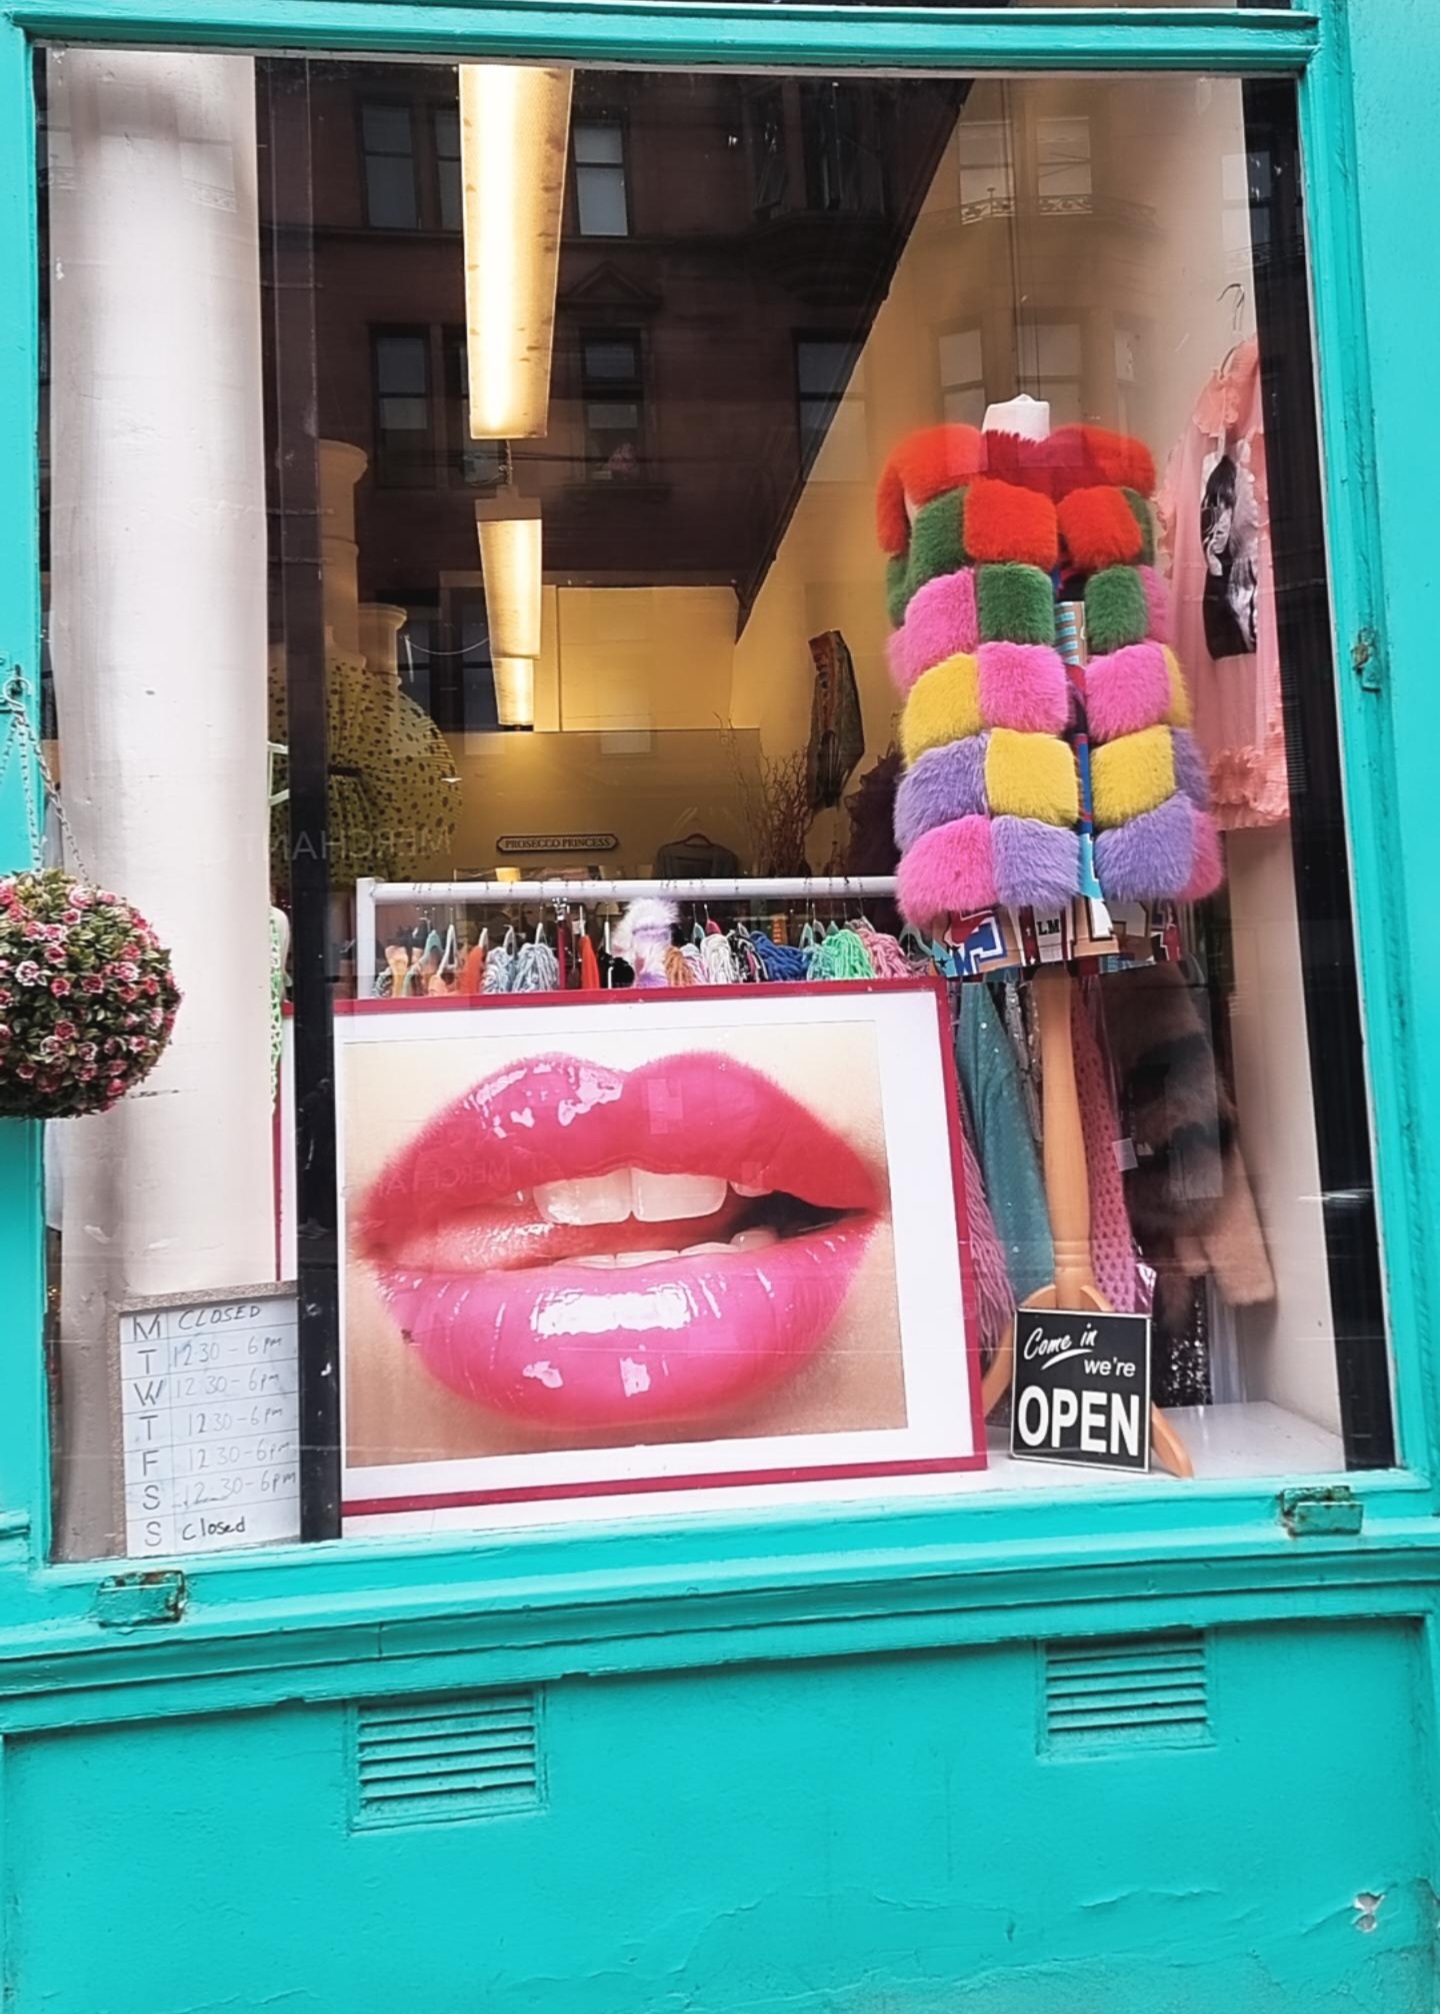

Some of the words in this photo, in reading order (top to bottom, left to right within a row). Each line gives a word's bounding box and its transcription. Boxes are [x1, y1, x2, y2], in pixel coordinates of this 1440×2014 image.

[505, 839, 560, 849] PROSECCO
[562, 837, 611, 848] PRINCESS
[133, 1313, 160, 1341] M
[178, 1305, 261, 1331] CLOSED
[1023, 1327, 1072, 1360] Come
[1080, 1322, 1098, 1347] in
[137, 1348, 157, 1375] T
[1084, 1356, 1136, 1378] we're
[133, 1379, 165, 1406] W
[138, 1415, 158, 1441] T
[1017, 1384, 1140, 1457] OPEN
[142, 1450, 160, 1477] F
[142, 1484, 161, 1511] S
[143, 1521, 162, 1547] S
[182, 1516, 246, 1541] Closed
